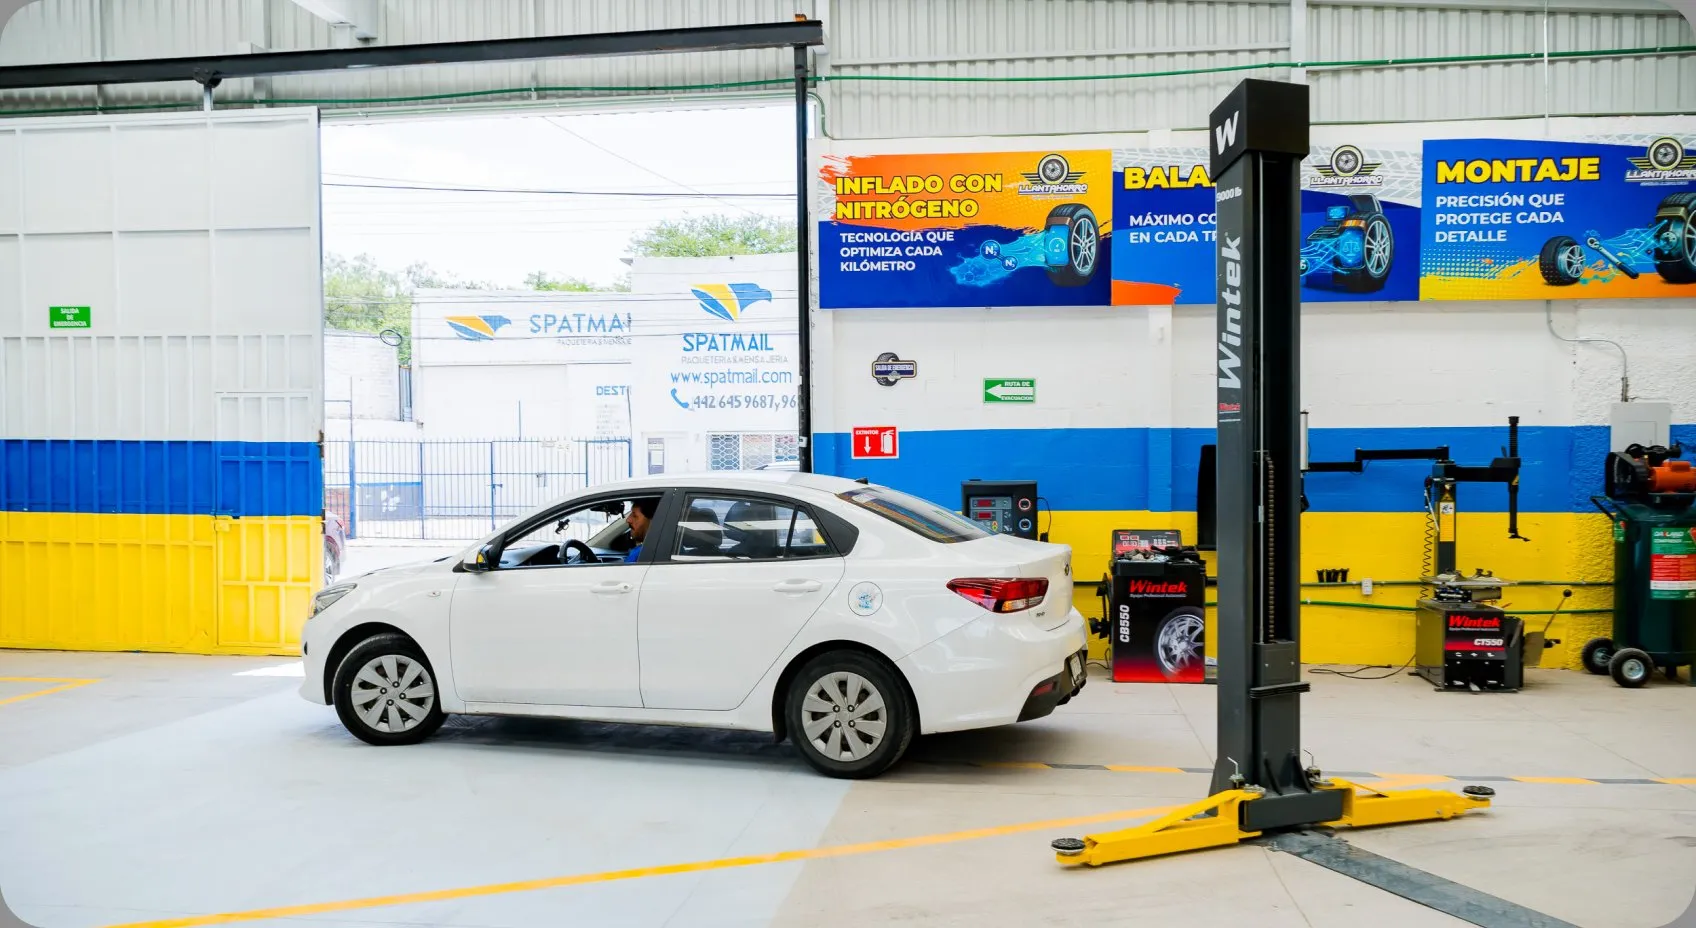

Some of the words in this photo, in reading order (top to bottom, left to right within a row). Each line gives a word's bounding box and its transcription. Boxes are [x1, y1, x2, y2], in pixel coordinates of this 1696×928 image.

[1215, 110, 1239, 155] W
[1124, 164, 1217, 190] BALA
[1436, 157, 1600, 184] MONTAJE
[836, 175, 944, 195] INFLADO
[949, 174, 1003, 193] CON
[1310, 175, 1384, 186] LLANTAHORRO
[1018, 184, 1088, 195] LLANTAHORRO
[1436, 192, 1524, 208] PRECISIÓN
[1528, 194, 1565, 208] QUE
[836, 195, 979, 220] NITRÓGENO
[1129, 212, 1194, 227] MÁXIMO
[1435, 213, 1512, 225] PROTEGE
[1516, 212, 1564, 224] CADA
[840, 231, 923, 243] TECNOLOGÍA
[926, 231, 955, 243] QUE
[1129, 232, 1150, 244] EN
[1154, 231, 1199, 243] CADA
[1435, 230, 1507, 243] DETALLE
[840, 247, 902, 257] OPTIMIZA
[905, 246, 943, 256] CADA
[840, 259, 916, 272] KILÓMETRO
[1218, 236, 1242, 389] Wintek
[682, 333, 774, 351] SPATMAIL
[670, 368, 792, 388] www.spatmail.com
[693, 395, 716, 408] 442
[718, 395, 742, 408] 645
[1130, 580, 1187, 593] Wintek
[1119, 604, 1130, 643] CB550
[1449, 615, 1500, 628] Wintek
[1473, 638, 1504, 646] CT550
